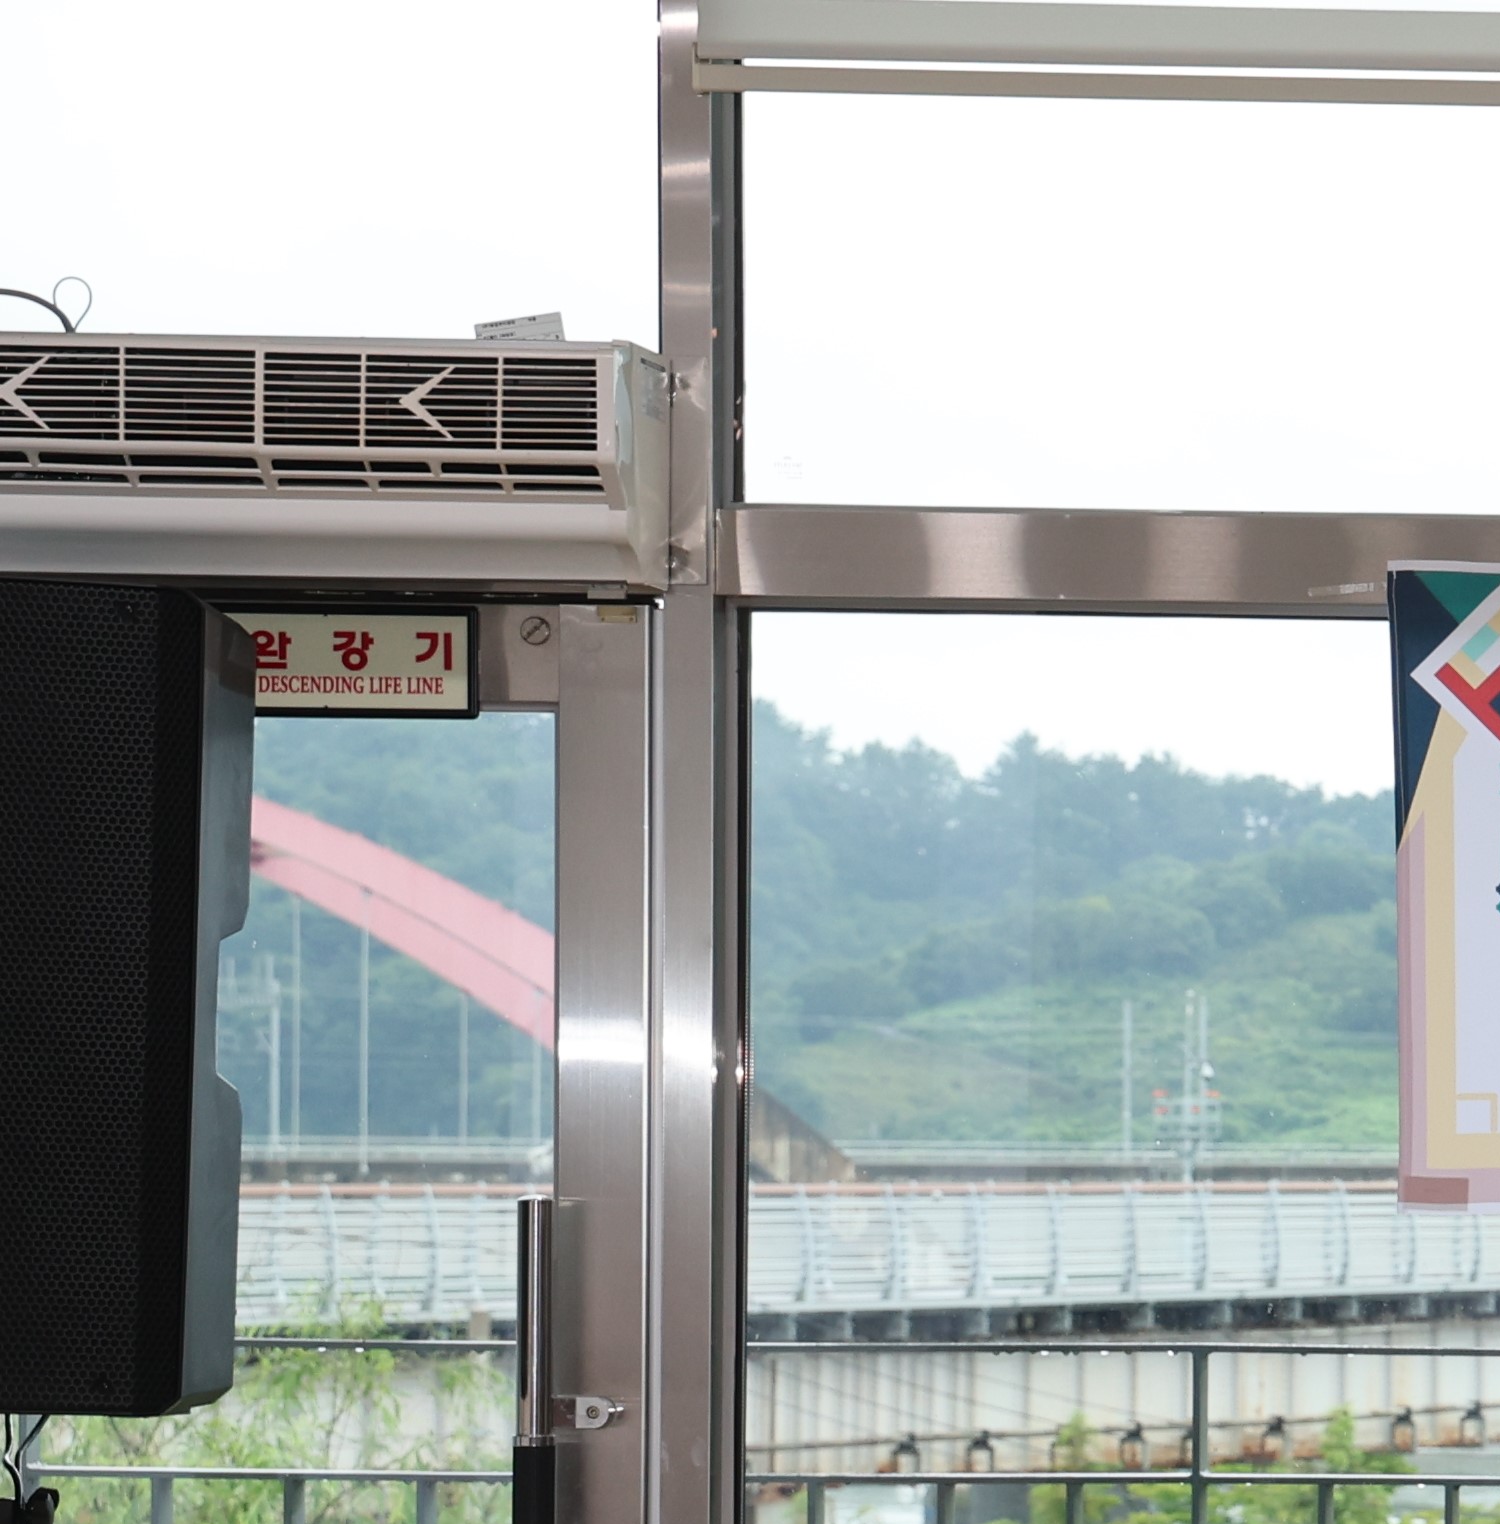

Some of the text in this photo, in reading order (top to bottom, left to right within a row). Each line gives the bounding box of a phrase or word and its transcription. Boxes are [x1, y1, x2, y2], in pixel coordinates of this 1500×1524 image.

[258, 675, 444, 695] DESCENDING LIFE LINE
